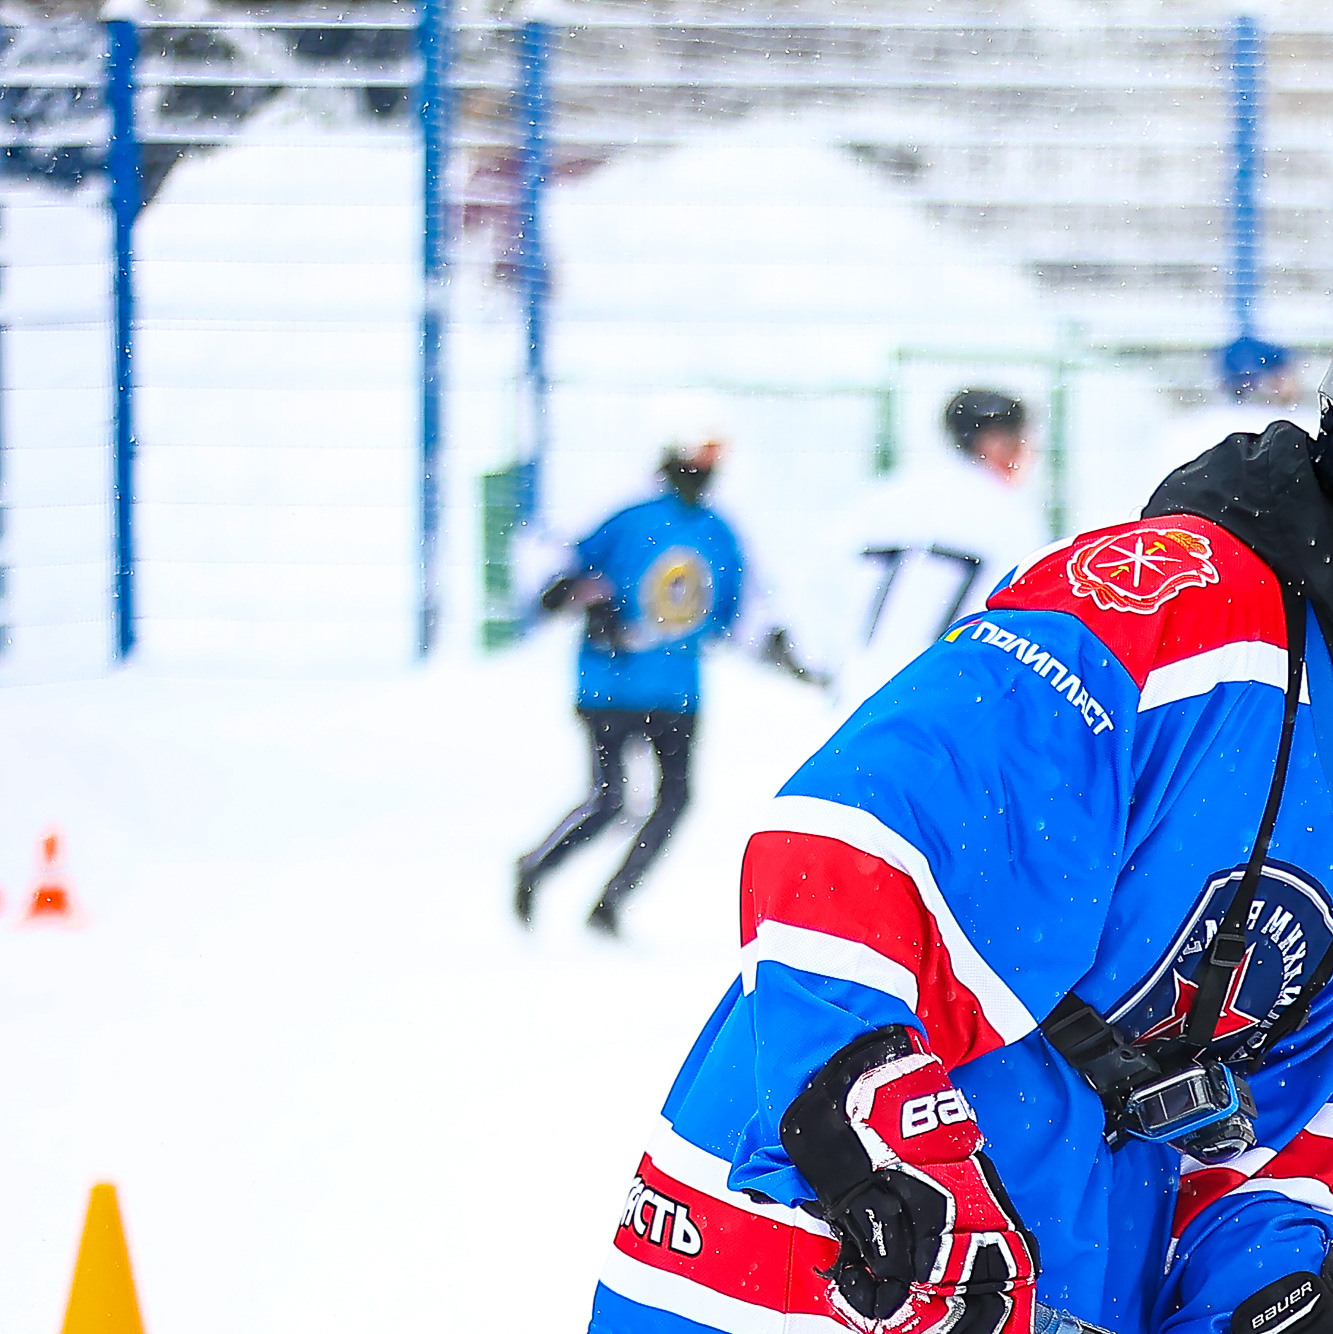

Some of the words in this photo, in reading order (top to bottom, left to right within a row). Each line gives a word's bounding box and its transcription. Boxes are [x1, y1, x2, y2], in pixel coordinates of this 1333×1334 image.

[861, 543, 982, 646] 77
[970, 621, 1115, 735] ПОЛИПЛАСТ
[1251, 1281, 1313, 1330] BAUER
